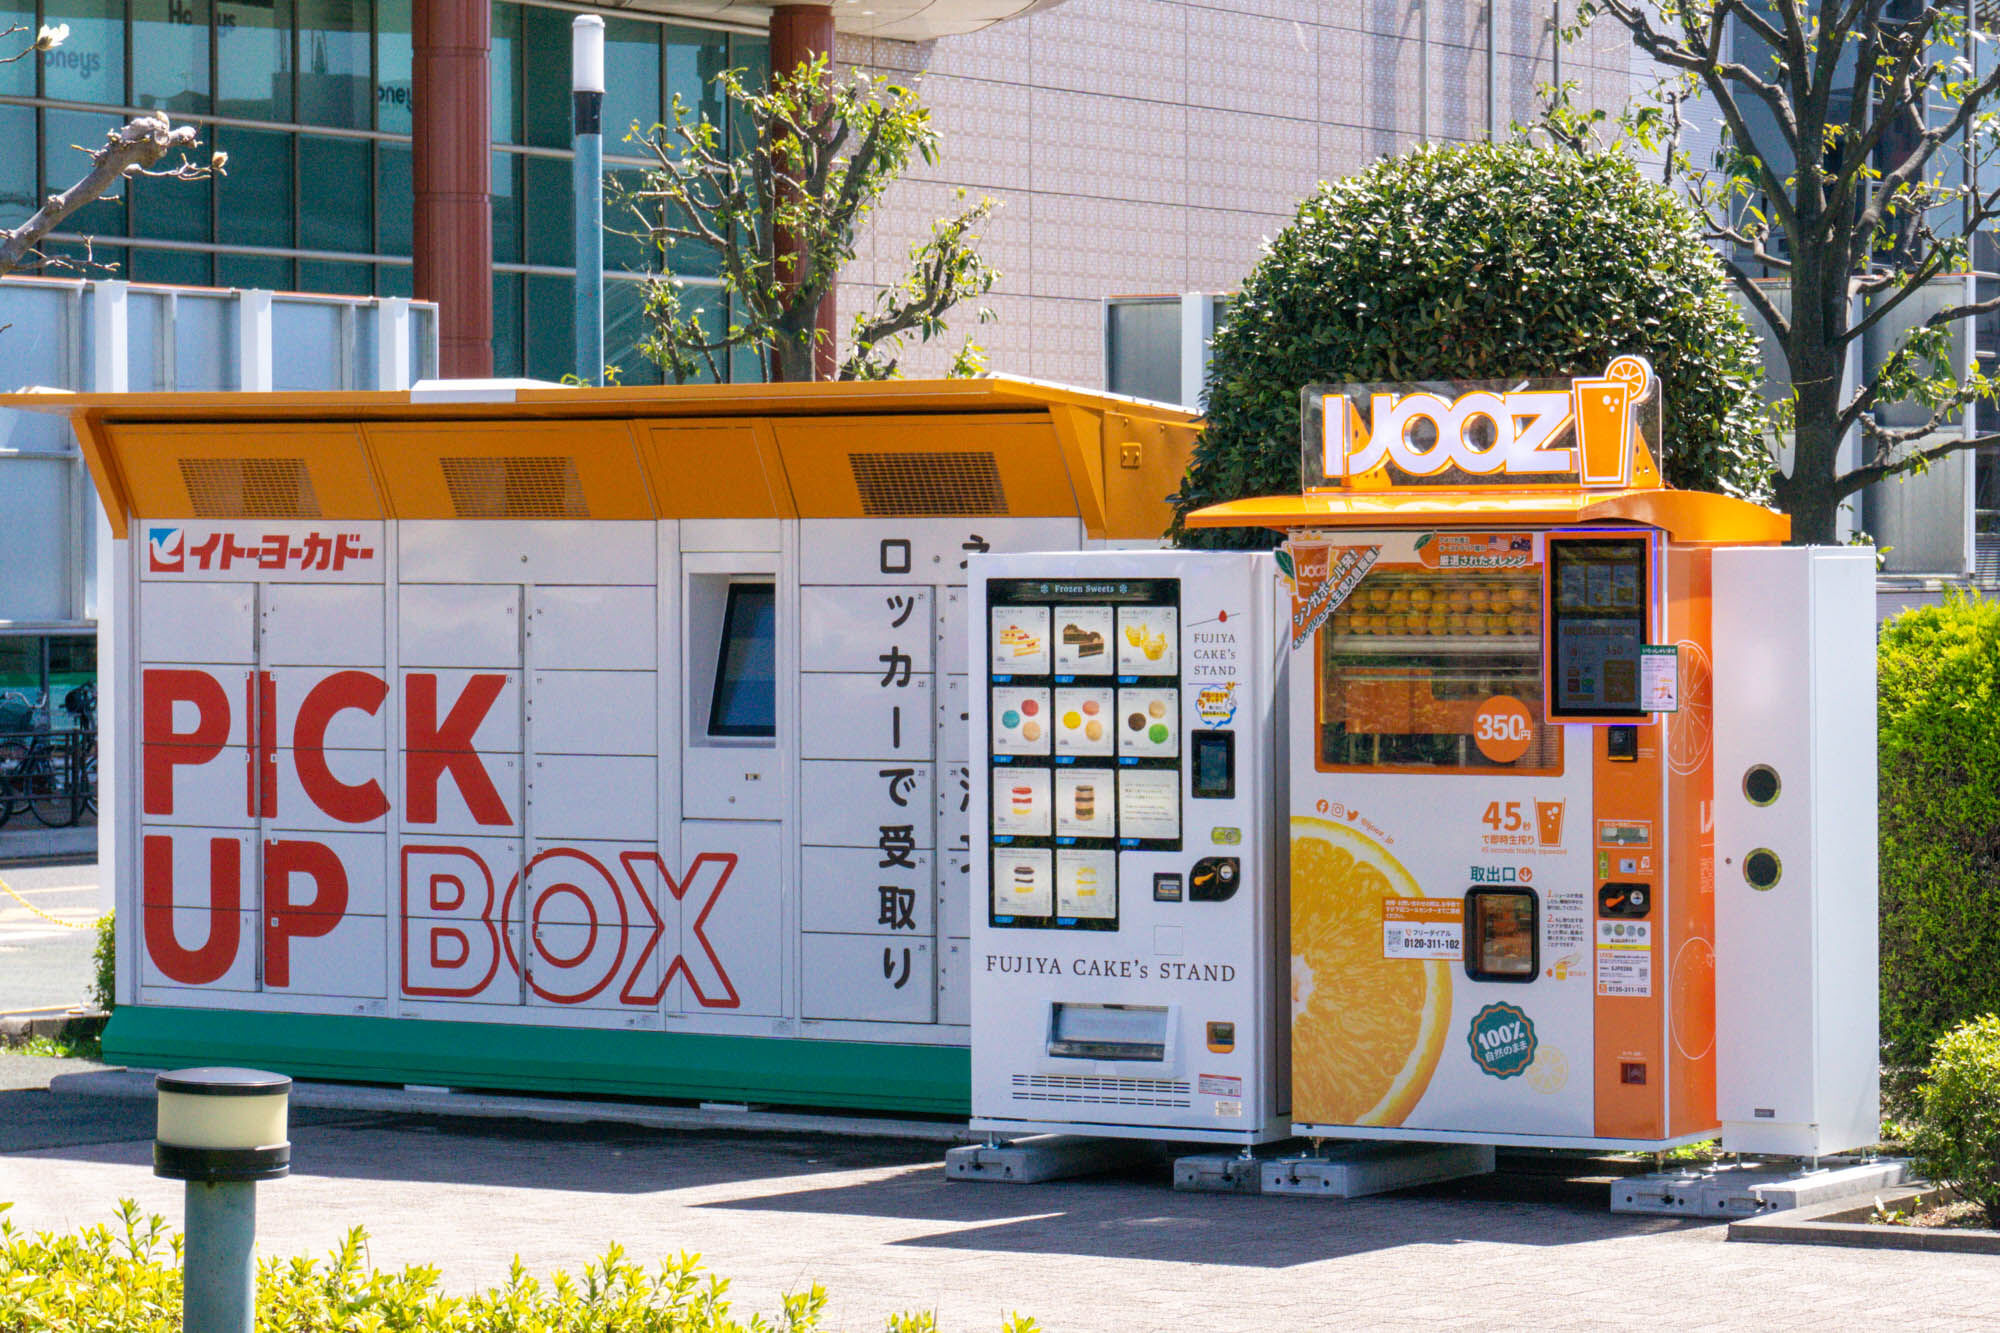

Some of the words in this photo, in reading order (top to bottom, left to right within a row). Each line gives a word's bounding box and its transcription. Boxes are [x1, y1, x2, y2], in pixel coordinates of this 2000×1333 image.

[190, 532, 374, 571] イトーヨーカドー
[1054, 583, 1084, 594] Frozen
[1086, 584, 1114, 594] Sweets
[1193, 633, 1236, 644] FUJIYA
[1193, 648, 1237, 660] CAKE's
[1193, 664, 1237, 676] STAND
[1477, 714, 1531, 741] 350円
[143, 669, 514, 826] PICK
[878, 539, 917, 989] ロッカーで受取り
[1470, 865, 1516, 882] 取出口
[143, 835, 349, 987] UP
[400, 845, 740, 1008] BOX
[1412, 929, 1452, 937] フリーダイアル
[1404, 938, 1460, 950] 0120-311-102
[986, 955, 1062, 975] FUJIYA
[1073, 959, 1149, 979] CAKE's
[1159, 963, 1236, 982] STAND
[1478, 1020, 1525, 1050] 100%
[1484, 1040, 1528, 1063] 自然のまま
